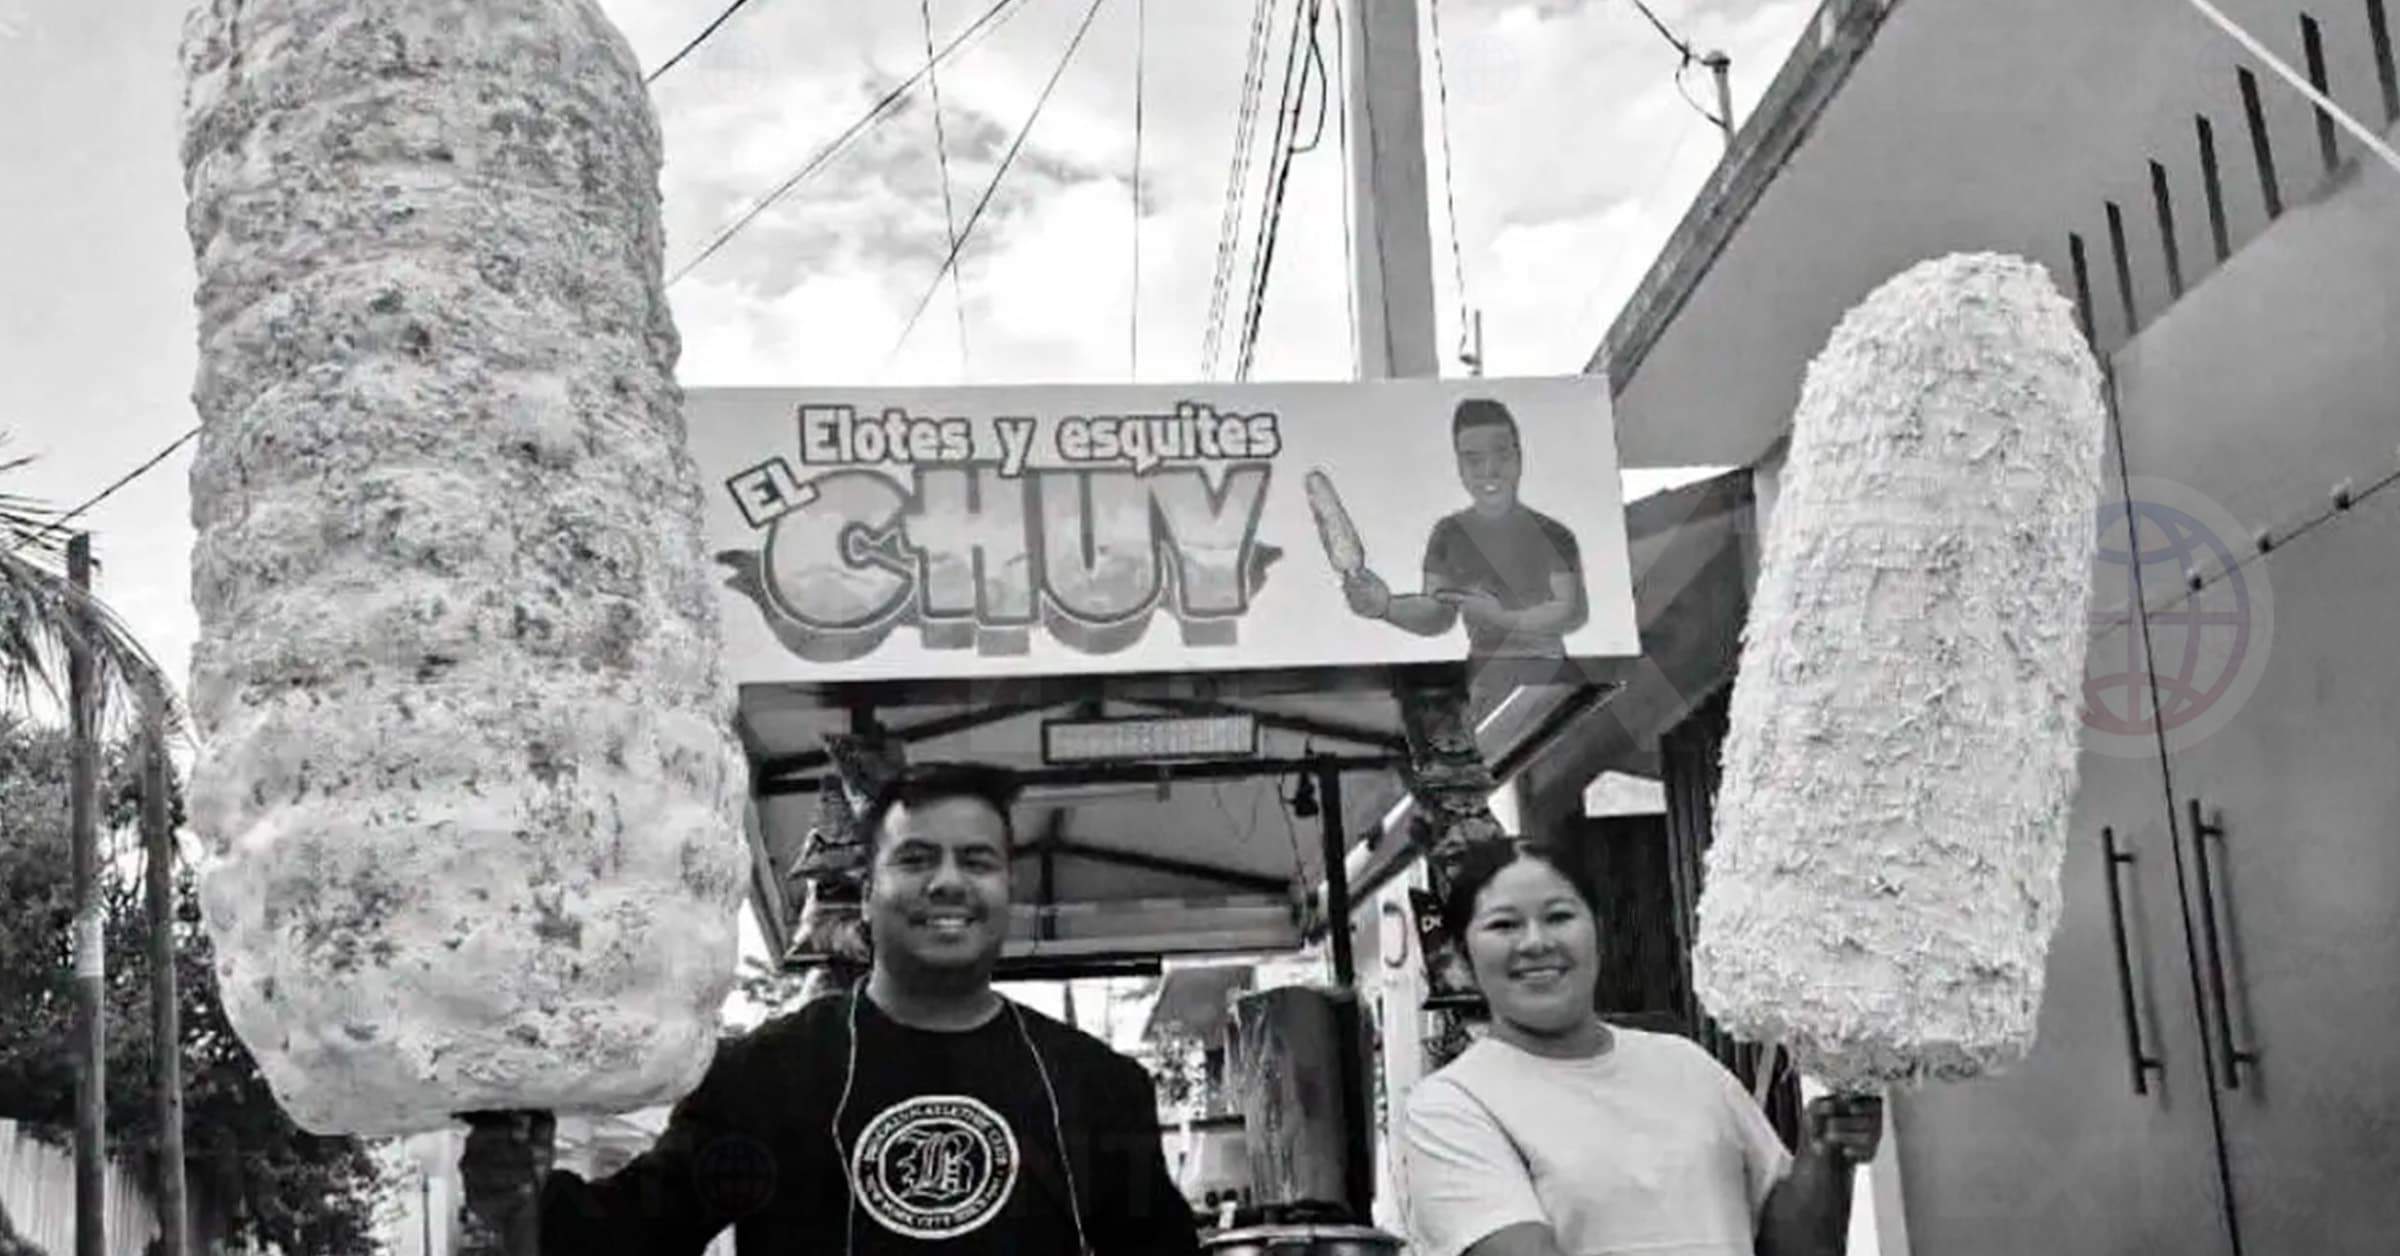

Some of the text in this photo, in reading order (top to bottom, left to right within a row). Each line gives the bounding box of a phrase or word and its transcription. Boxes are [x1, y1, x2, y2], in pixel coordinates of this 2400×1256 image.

[800, 402, 1282, 478] Elotes y esquites
[726, 457, 1271, 642] EL CHUY
